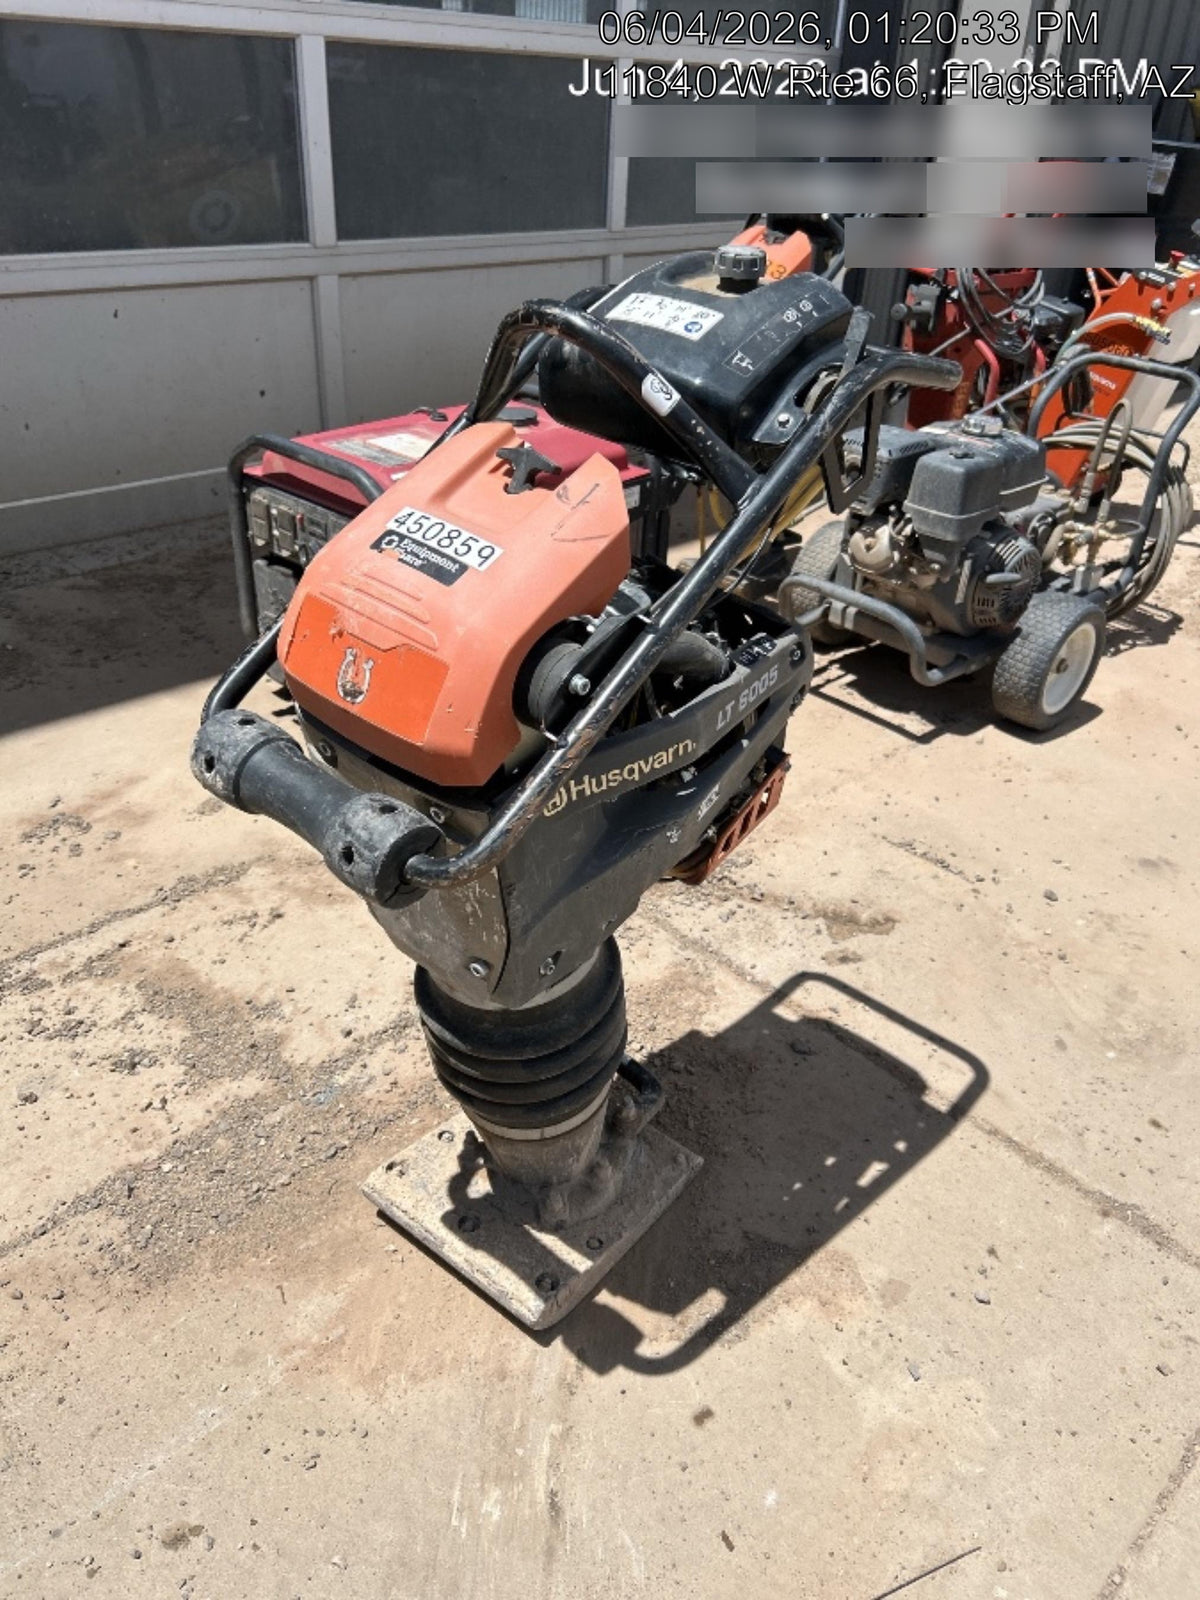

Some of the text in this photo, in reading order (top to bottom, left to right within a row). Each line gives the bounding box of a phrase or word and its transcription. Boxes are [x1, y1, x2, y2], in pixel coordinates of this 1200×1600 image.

[393, 511, 496, 567] 450859
[716, 663, 778, 731] LT 6005
[569, 738, 697, 801] Husqvarn
